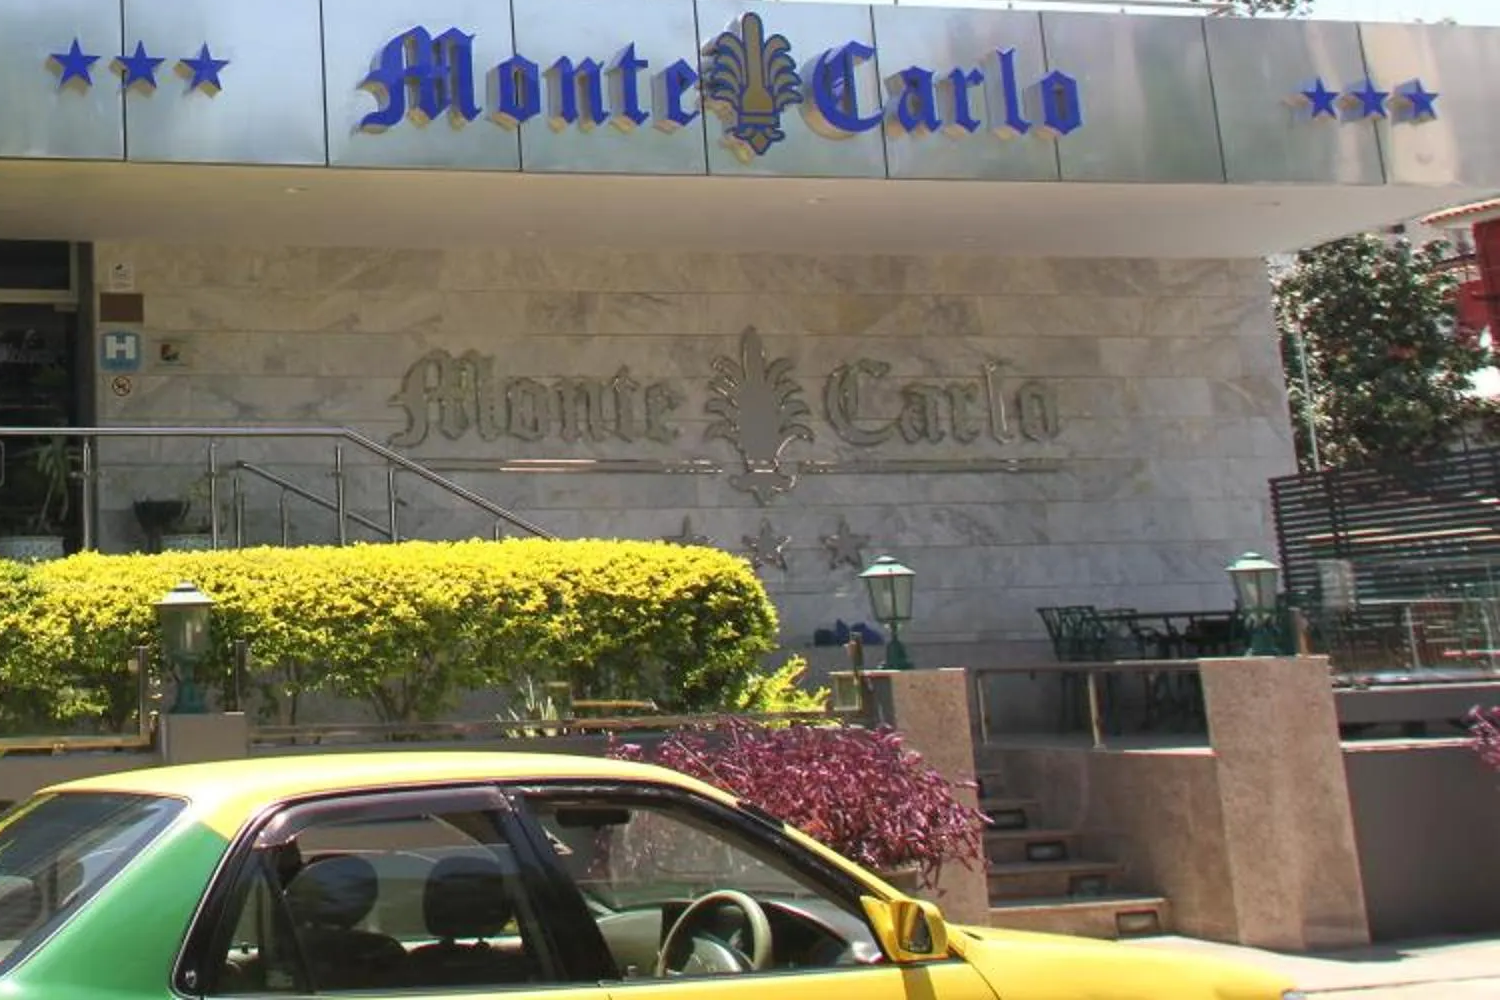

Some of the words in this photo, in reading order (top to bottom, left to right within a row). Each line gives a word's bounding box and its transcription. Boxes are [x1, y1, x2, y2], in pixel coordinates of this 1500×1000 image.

[353, 25, 700, 134] Monte
[802, 40, 1084, 138] Carlo
[105, 335, 136, 359] H
[388, 347, 682, 449] Monte
[823, 357, 1062, 447] Carlo
